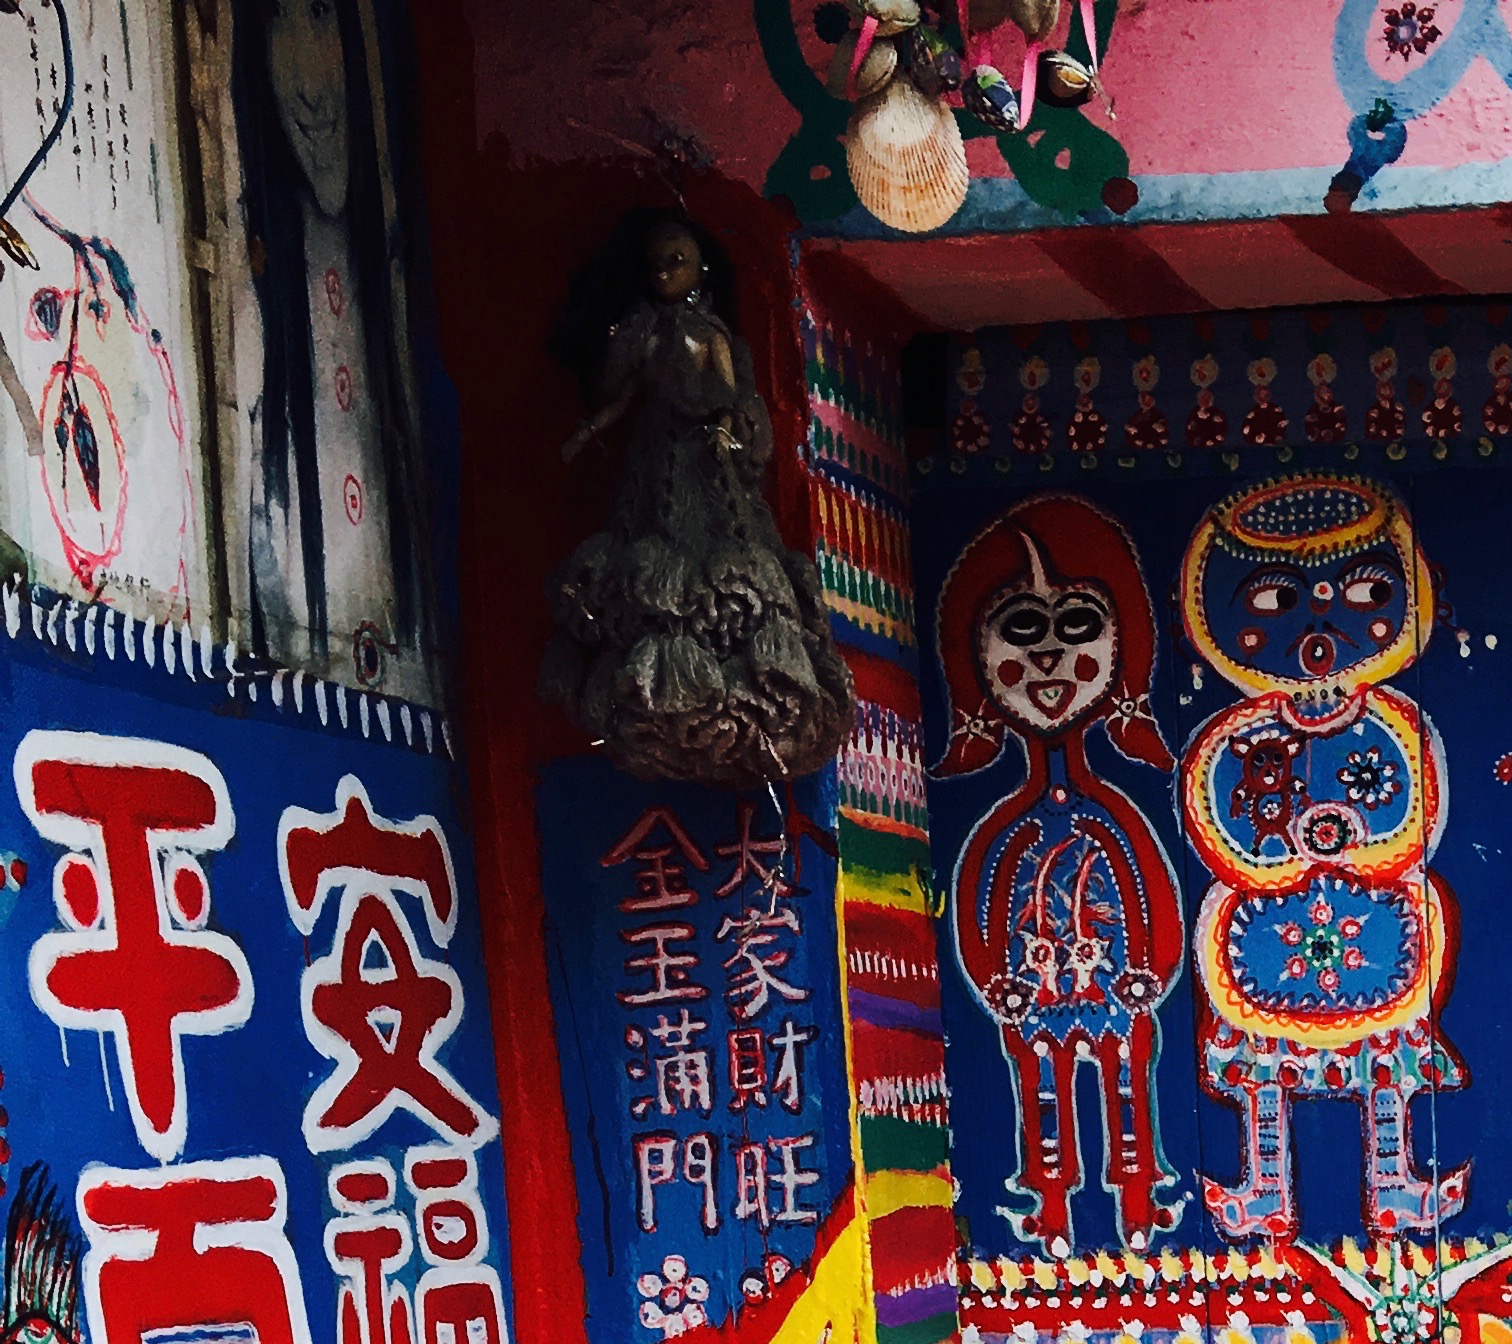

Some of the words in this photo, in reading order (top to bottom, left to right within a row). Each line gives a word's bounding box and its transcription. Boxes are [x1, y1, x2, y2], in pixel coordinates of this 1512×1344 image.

[15, 728, 500, 1163] 平安
[600, 804, 719, 1236] 金玉滿門
